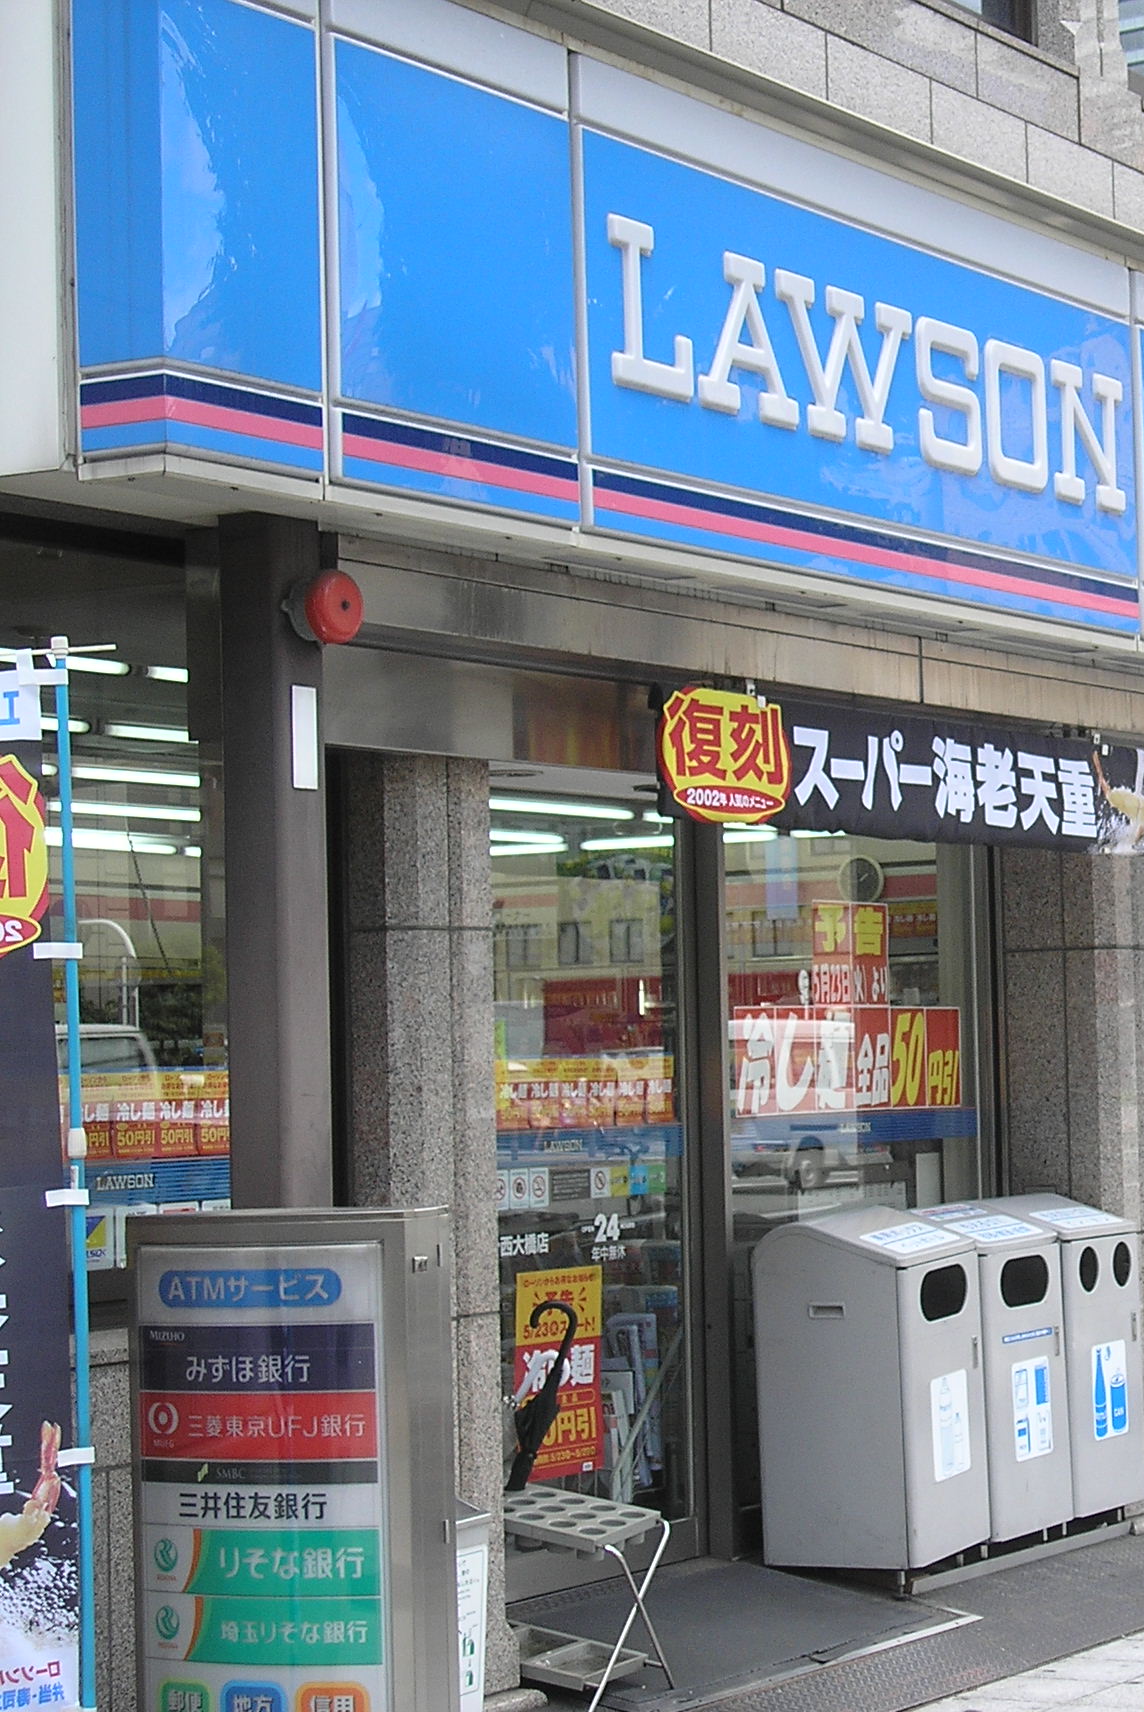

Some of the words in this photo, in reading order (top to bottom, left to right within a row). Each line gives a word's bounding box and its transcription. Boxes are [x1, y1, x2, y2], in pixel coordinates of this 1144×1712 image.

[607, 213, 1127, 514] LAWSON
[668, 695, 784, 785] 復刻
[793, 725, 1097, 838] スーパー海老天重
[815, 903, 884, 956] 予告
[95, 1173, 155, 1190] LAWSON
[594, 1213, 620, 1243] 24
[591, 1245, 627, 1261] 年中無休
[167, 1274, 330, 1301] ATMサービス
[186, 1354, 310, 1383] みずほ銀行
[188, 1414, 367, 1439] 三菱東京UFJ銀行
[216, 1467, 246, 1480] SMBC
[179, 1491, 328, 1520] 三井住友銀行
[219, 1547, 366, 1580] りそな銀行
[221, 1620, 369, 1644] 埼玉りそな銀行
